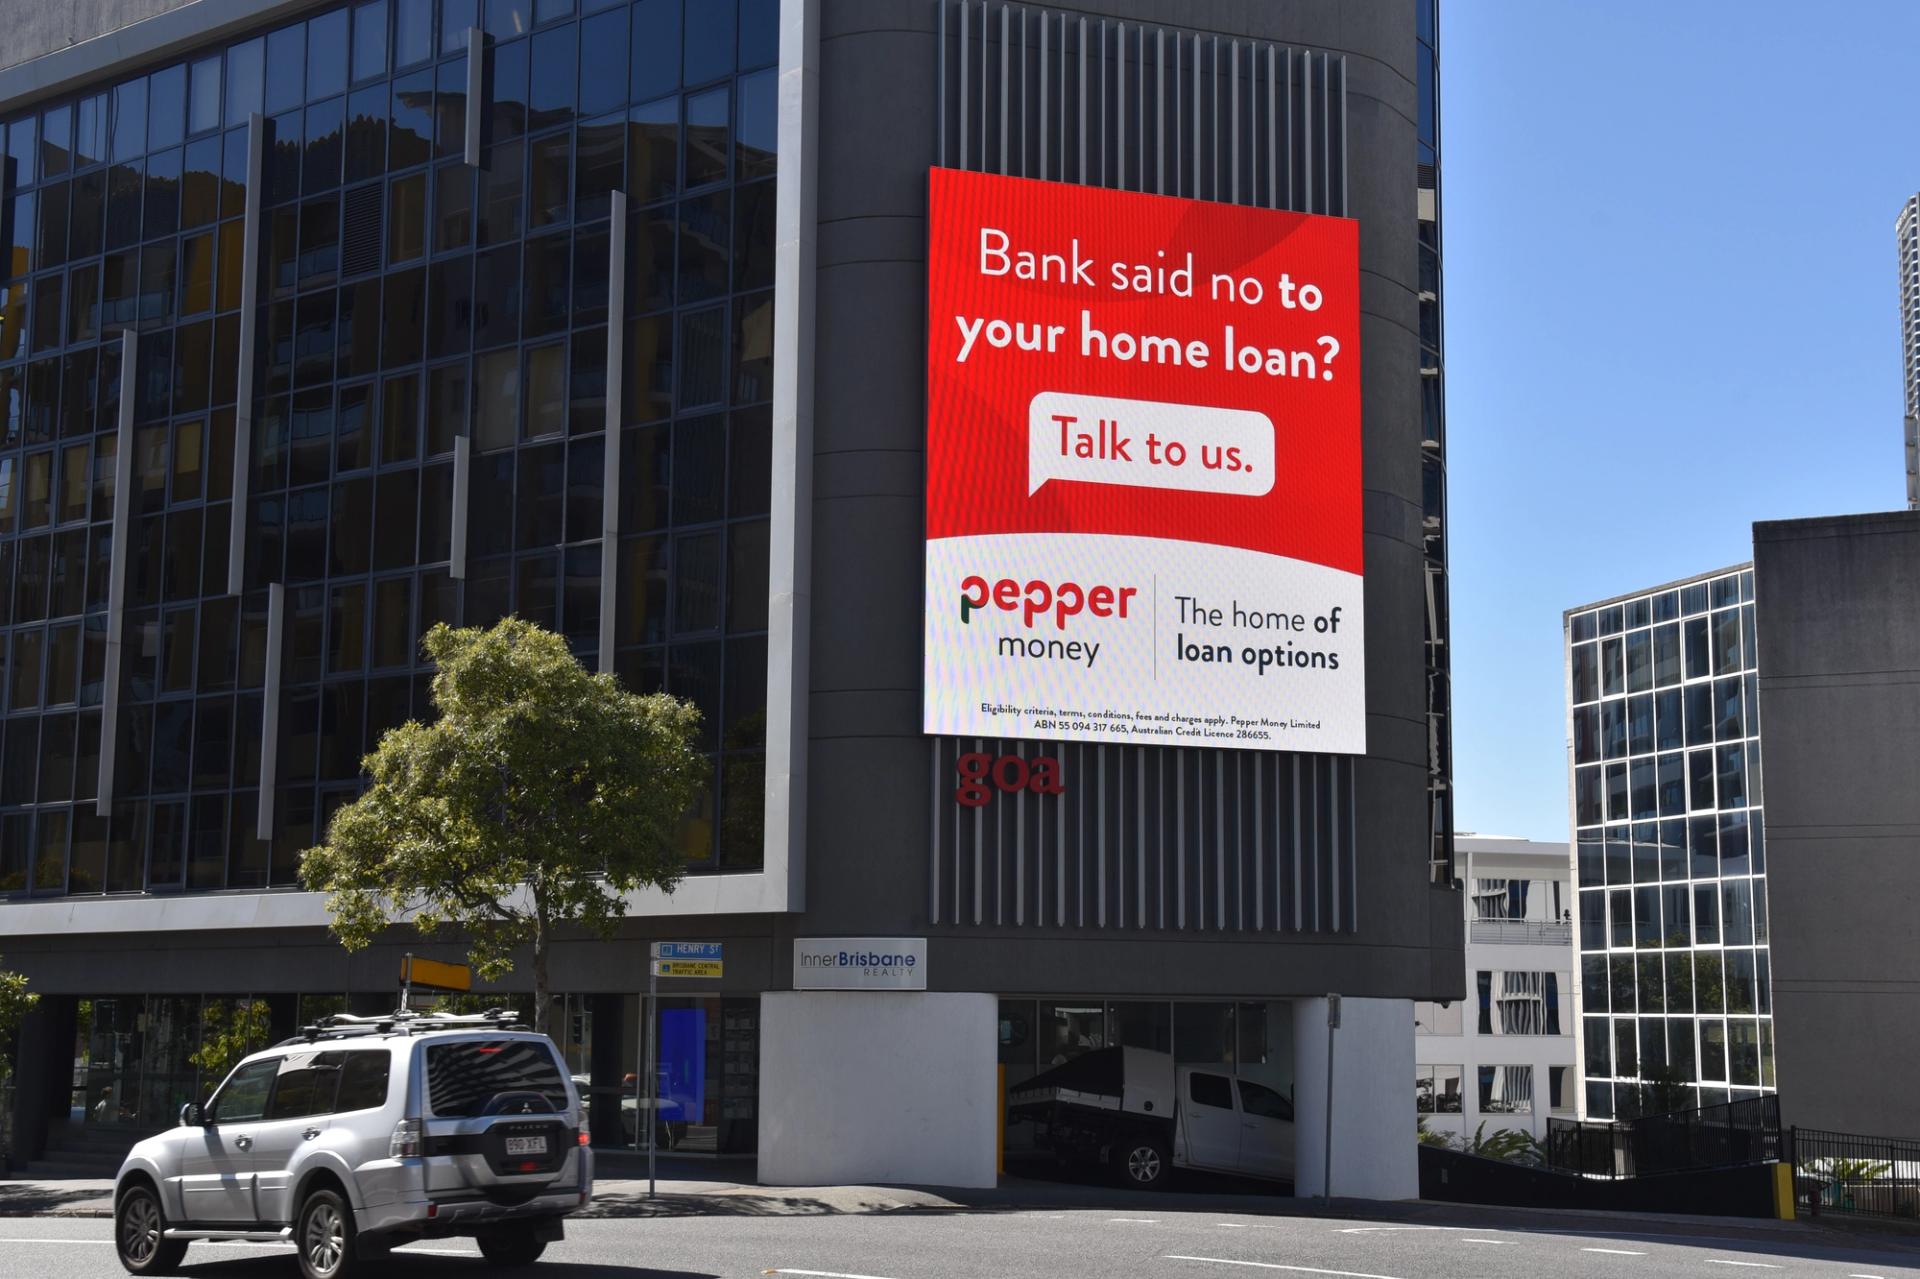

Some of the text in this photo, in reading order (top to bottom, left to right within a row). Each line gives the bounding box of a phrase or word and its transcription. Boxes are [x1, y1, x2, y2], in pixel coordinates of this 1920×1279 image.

[980, 227, 1323, 311] Bank said no to
[955, 309, 1341, 381] your home loan?
[1051, 414, 1254, 473] Talk to us.
[960, 574, 1137, 631] pepper
[1174, 595, 1342, 634] The home of
[998, 636, 1100, 668] money
[1176, 633, 1340, 675] loan options
[981, 703, 1321, 730] Eligibility criteria, terms, conditions, fees and charges apply. Pepper Money Limited
[1034, 720, 1272, 740] ABN 55 094 317 665, Australian Credit Licence 286655.
[955, 752, 1066, 807] goa
[677, 943, 705, 954] HENRY
[863, 968, 913, 977] REALTY
